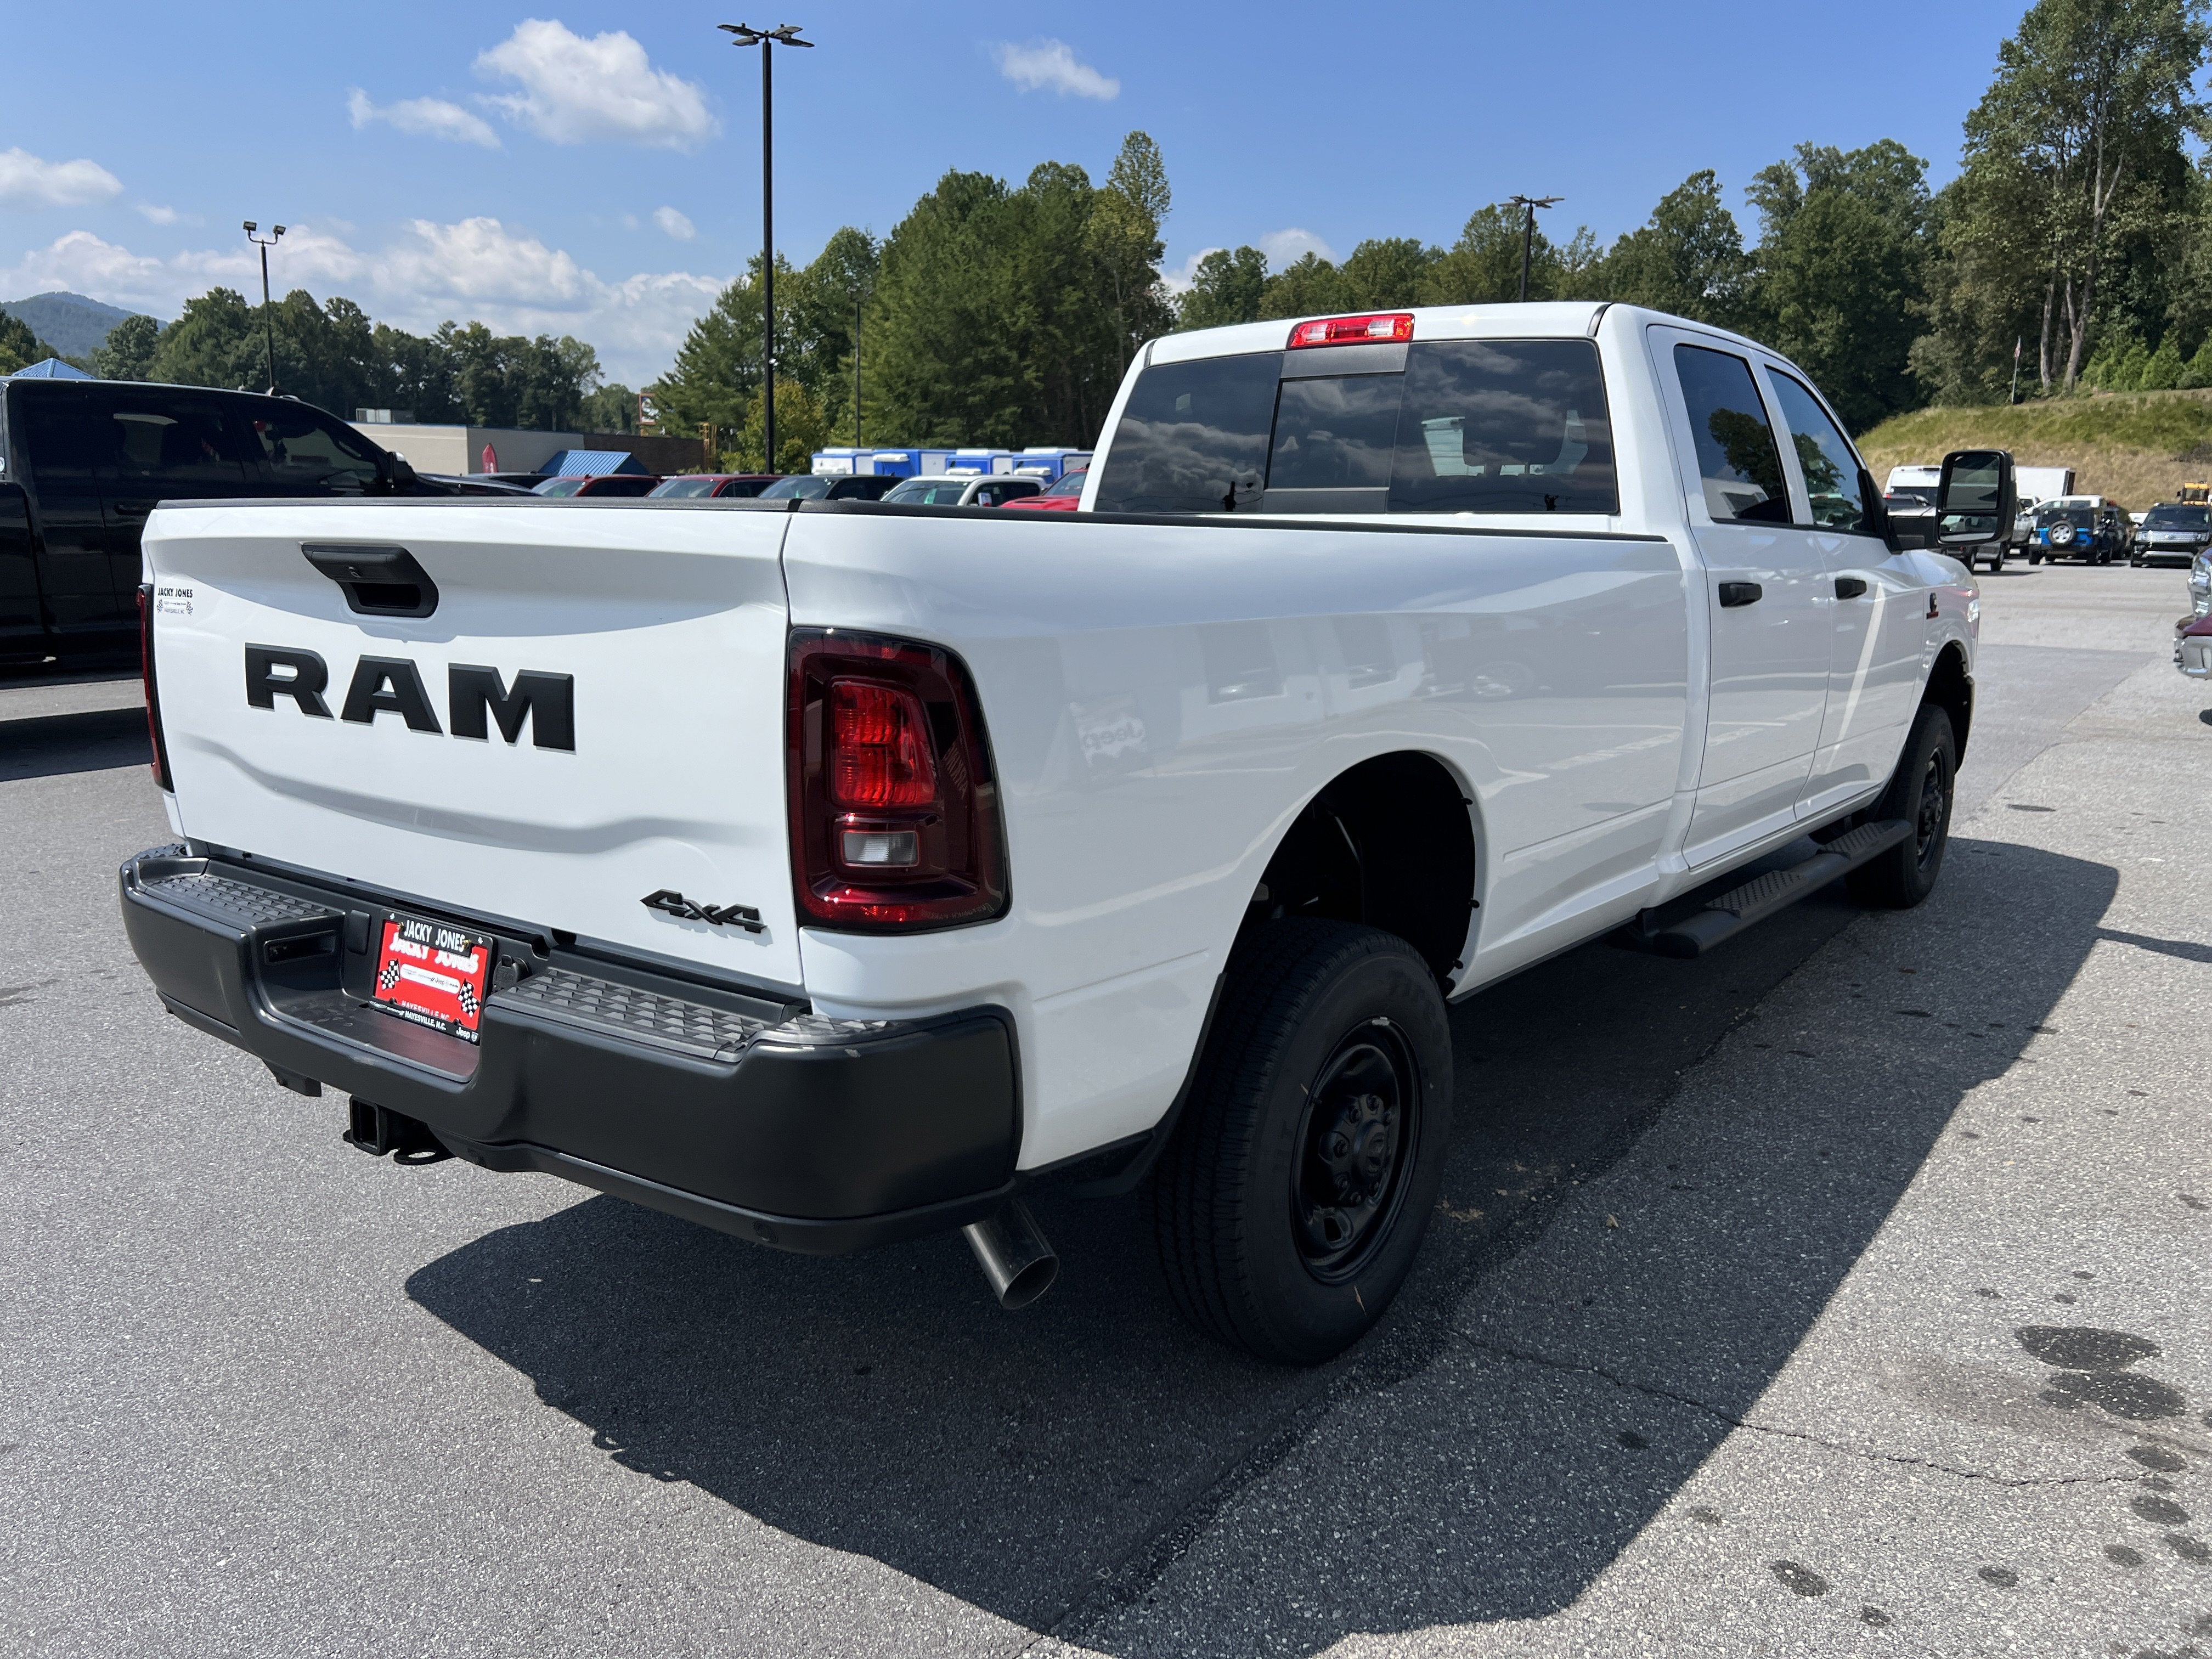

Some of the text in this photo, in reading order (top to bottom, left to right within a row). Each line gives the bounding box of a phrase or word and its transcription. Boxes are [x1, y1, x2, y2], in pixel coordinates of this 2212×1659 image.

[158, 588, 193, 598] JACKY JONES
[245, 642, 576, 752] RAM
[640, 888, 768, 934] 4x4
[404, 919, 465, 952] JACKY JONES
[456, 1027, 470, 1039] Jeep
